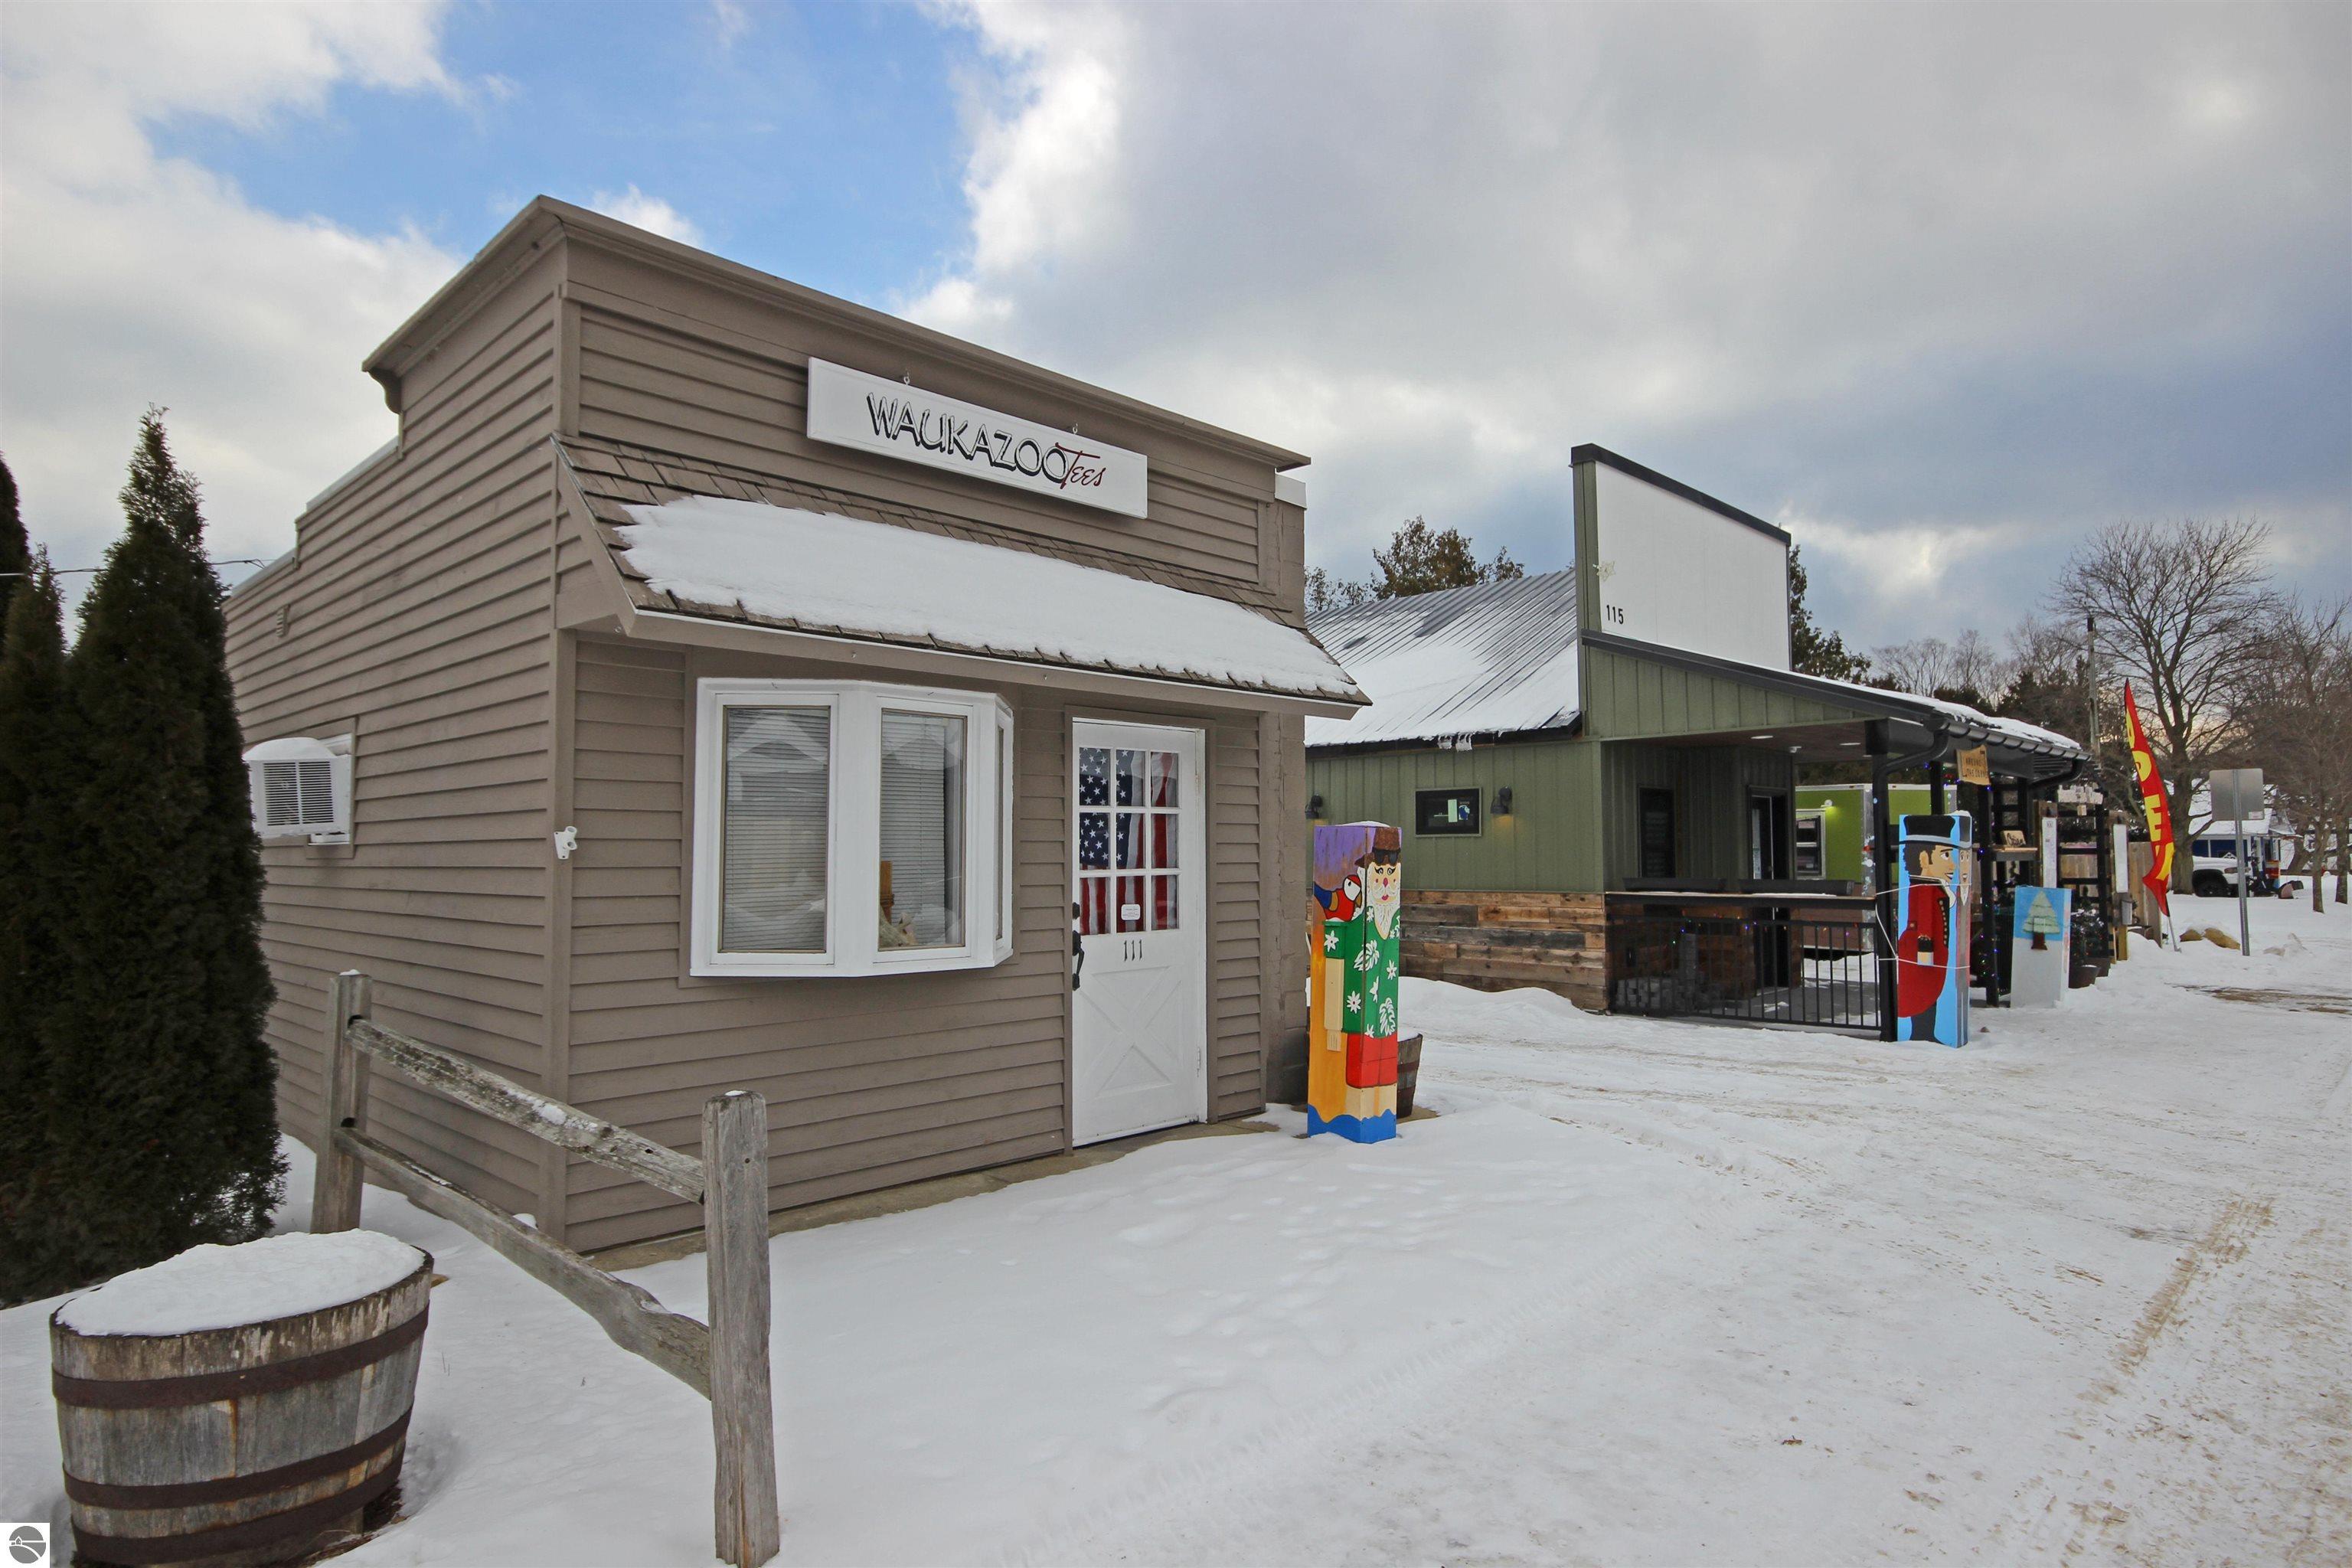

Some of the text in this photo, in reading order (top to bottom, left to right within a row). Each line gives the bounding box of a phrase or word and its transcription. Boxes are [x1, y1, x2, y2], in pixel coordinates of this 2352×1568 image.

[867, 392, 1069, 484] WAUKAZOO
[1606, 604, 1624, 625] 115
[1123, 939, 1142, 962] 111
